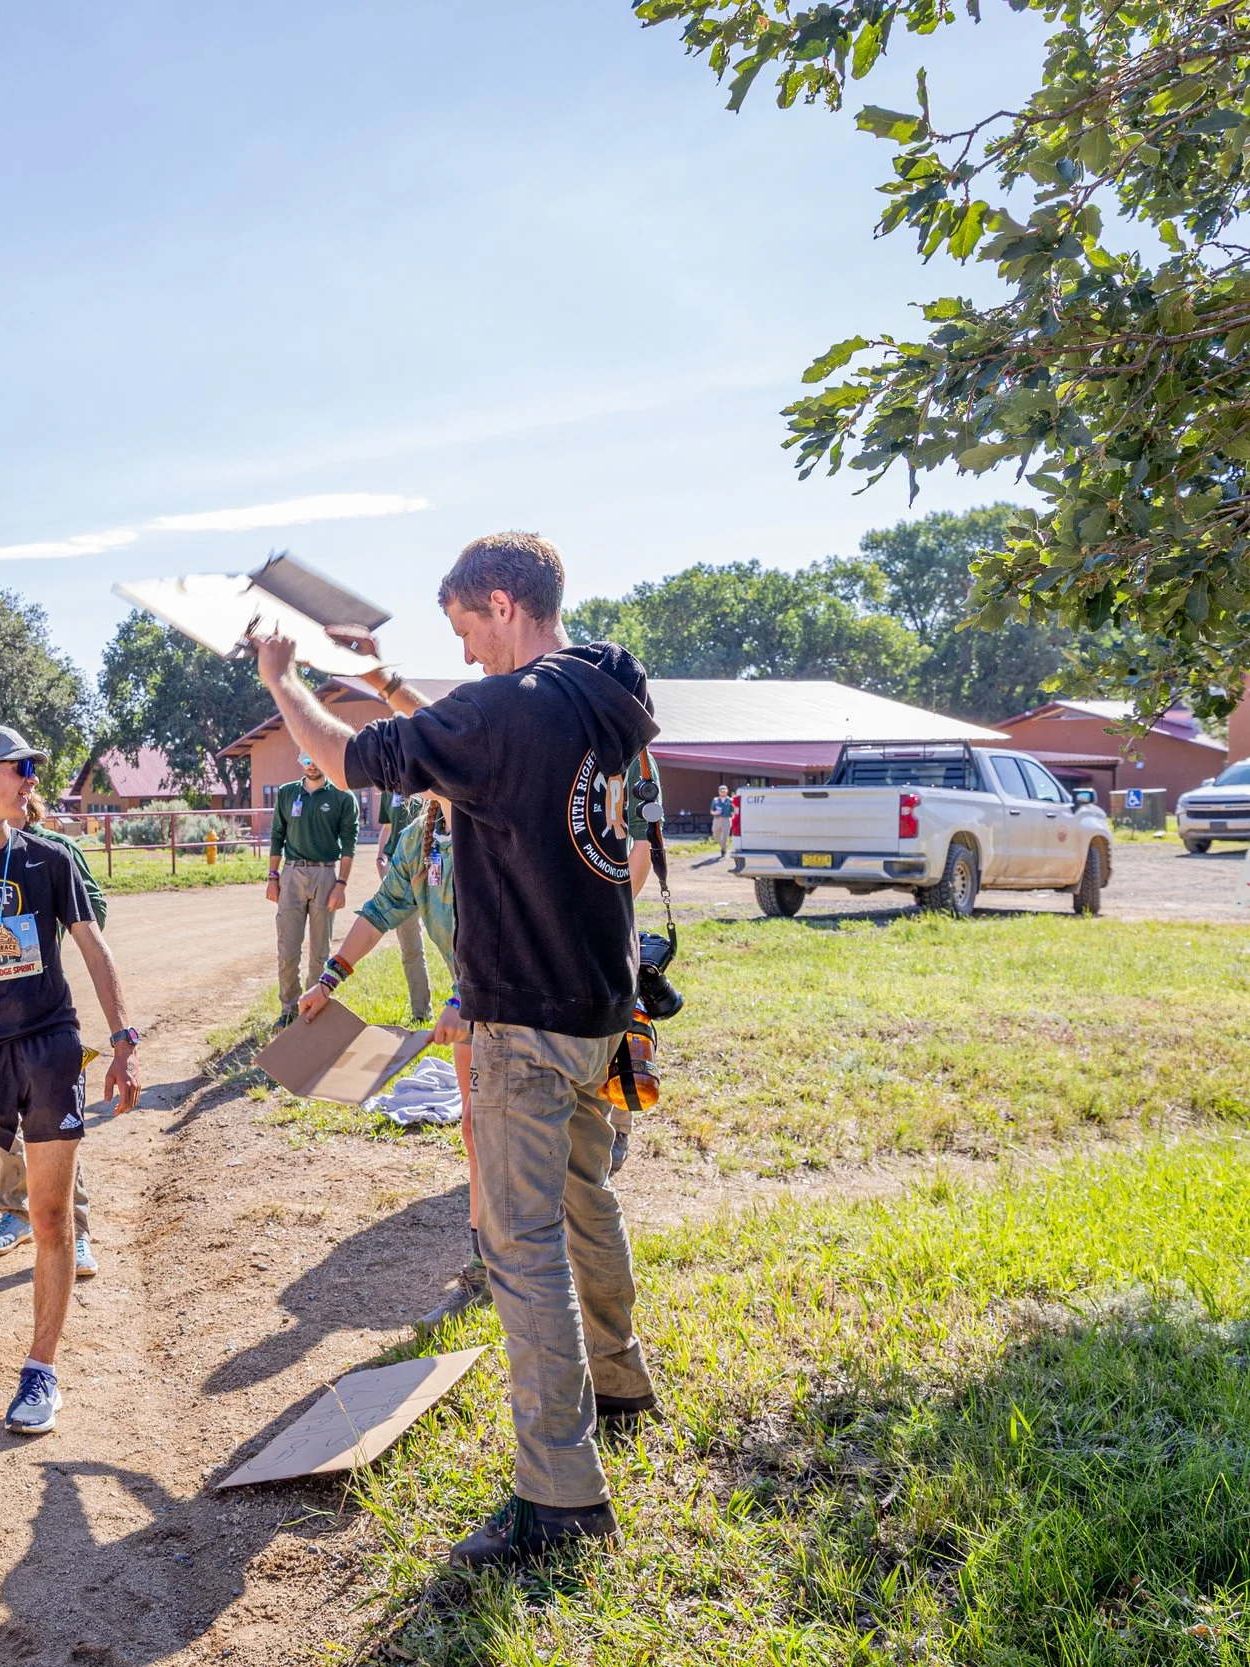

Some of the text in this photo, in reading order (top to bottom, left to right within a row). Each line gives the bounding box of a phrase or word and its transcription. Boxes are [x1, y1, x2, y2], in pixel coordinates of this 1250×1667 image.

[747, 795, 765, 804] C117
[571, 795, 586, 835] WITH
[616, 868, 630, 878] CON
[12, 963, 36, 975] SPRINT
